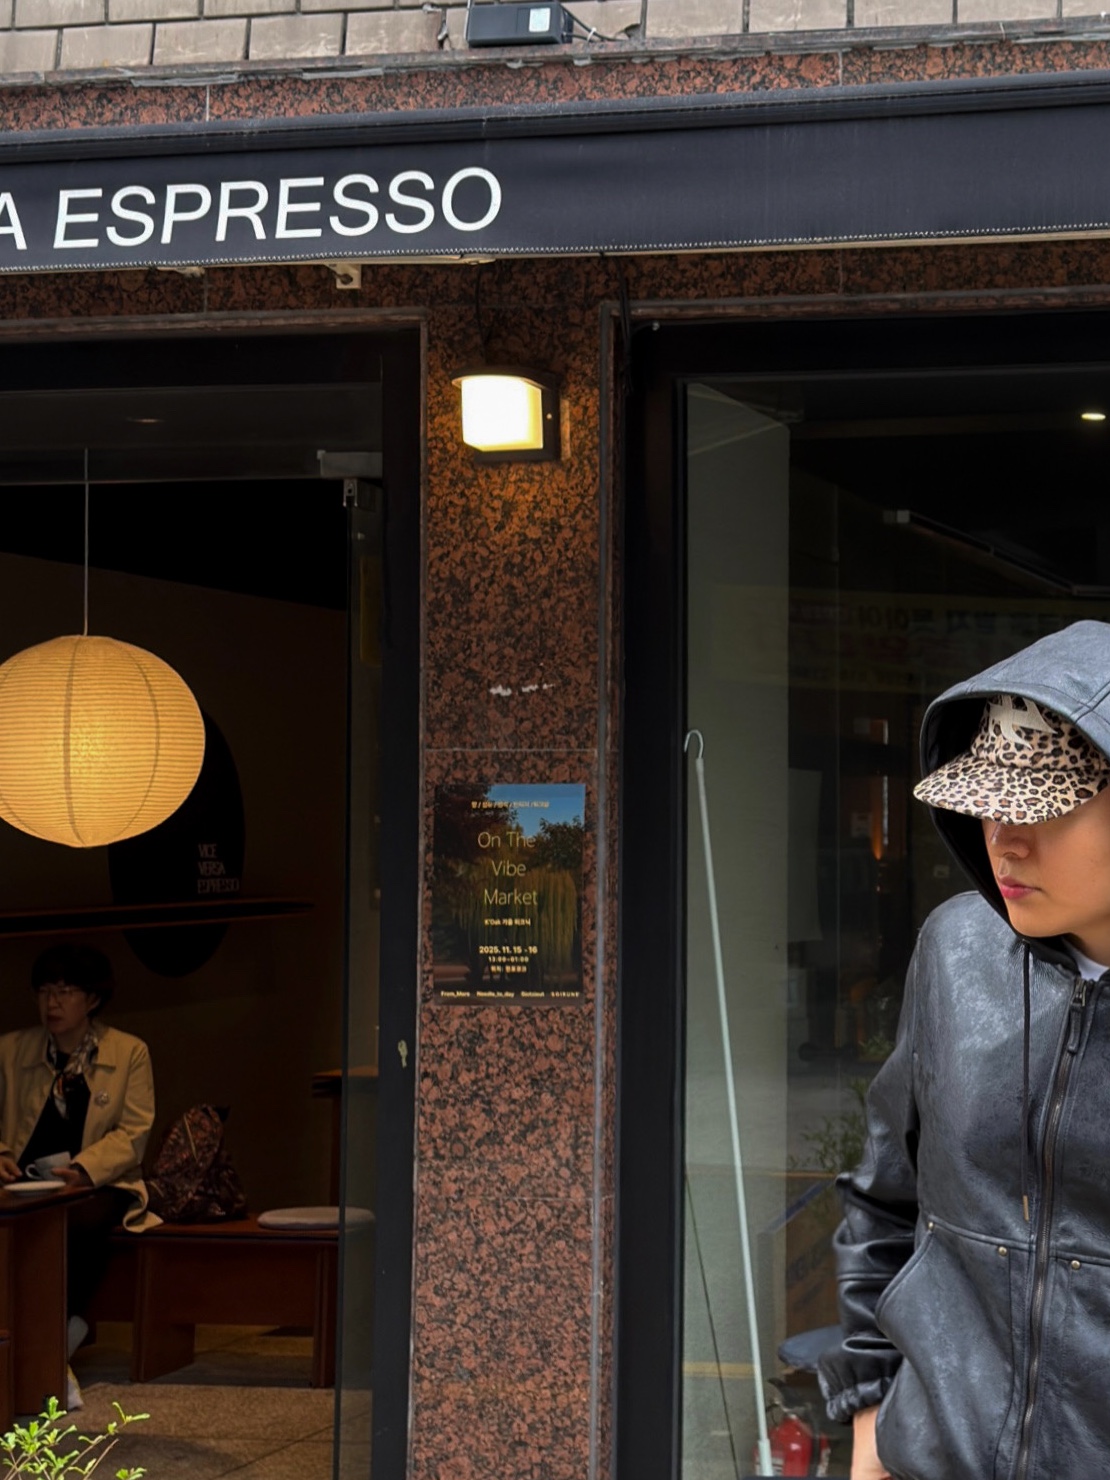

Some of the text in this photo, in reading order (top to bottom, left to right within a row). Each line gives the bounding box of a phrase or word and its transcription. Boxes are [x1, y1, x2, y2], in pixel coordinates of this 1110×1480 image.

[0, 166, 502, 250] A ESPRESSO
[478, 831, 537, 849] On The
[197, 842, 218, 859] VICE
[491, 860, 527, 877] Vibe
[484, 888, 538, 906] Market
[479, 945, 501, 954] 2025.
